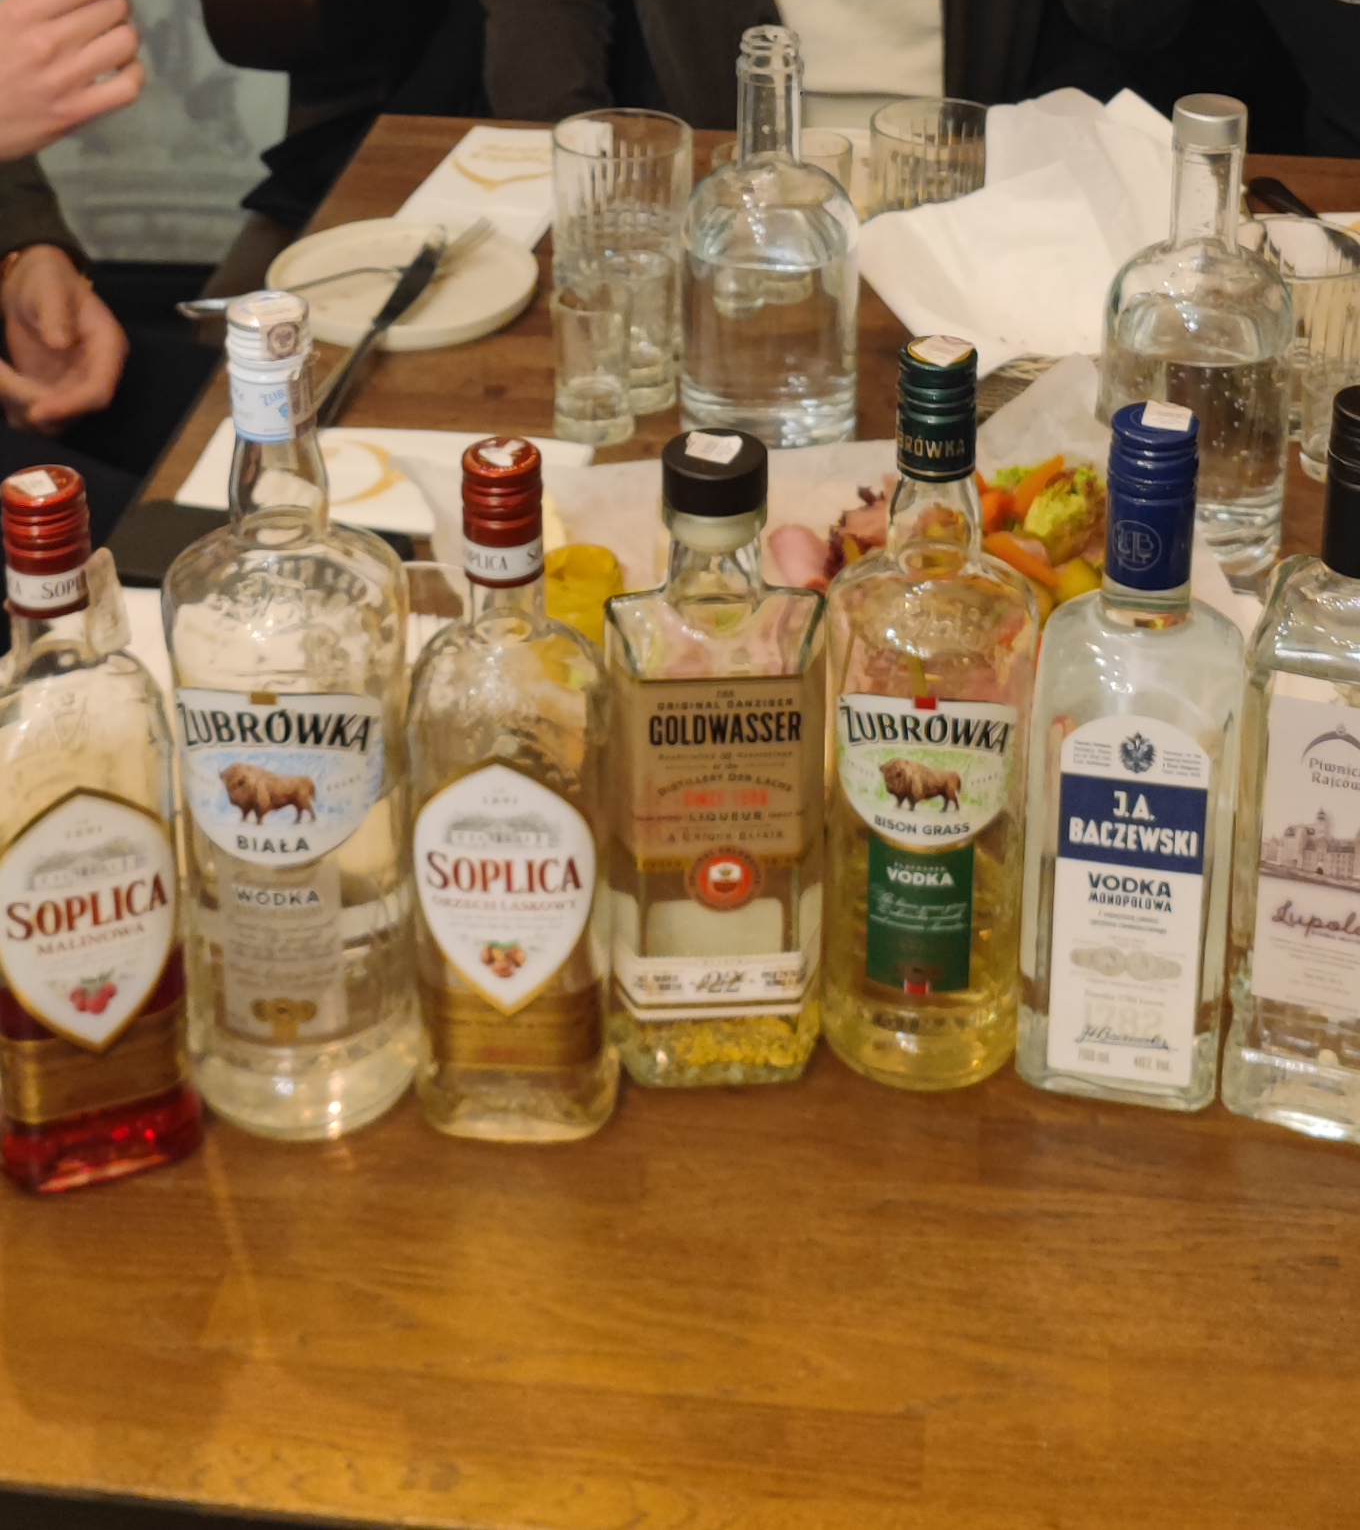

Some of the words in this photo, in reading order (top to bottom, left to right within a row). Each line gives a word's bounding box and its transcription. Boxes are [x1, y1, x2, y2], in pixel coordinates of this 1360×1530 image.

[649, 711, 802, 746] GOLDWASSER
[1113, 790, 1155, 821] J.A.
[874, 815, 917, 834] BISON
[923, 822, 970, 836] GRASS
[1069, 817, 1199, 858] BACZEWSKI
[237, 835, 310, 854] BIAŁA
[426, 851, 583, 895] SOPLICA
[886, 866, 955, 887] VODKA
[1088, 870, 1171, 898] VODKA
[6, 872, 168, 941] SOPLICA
